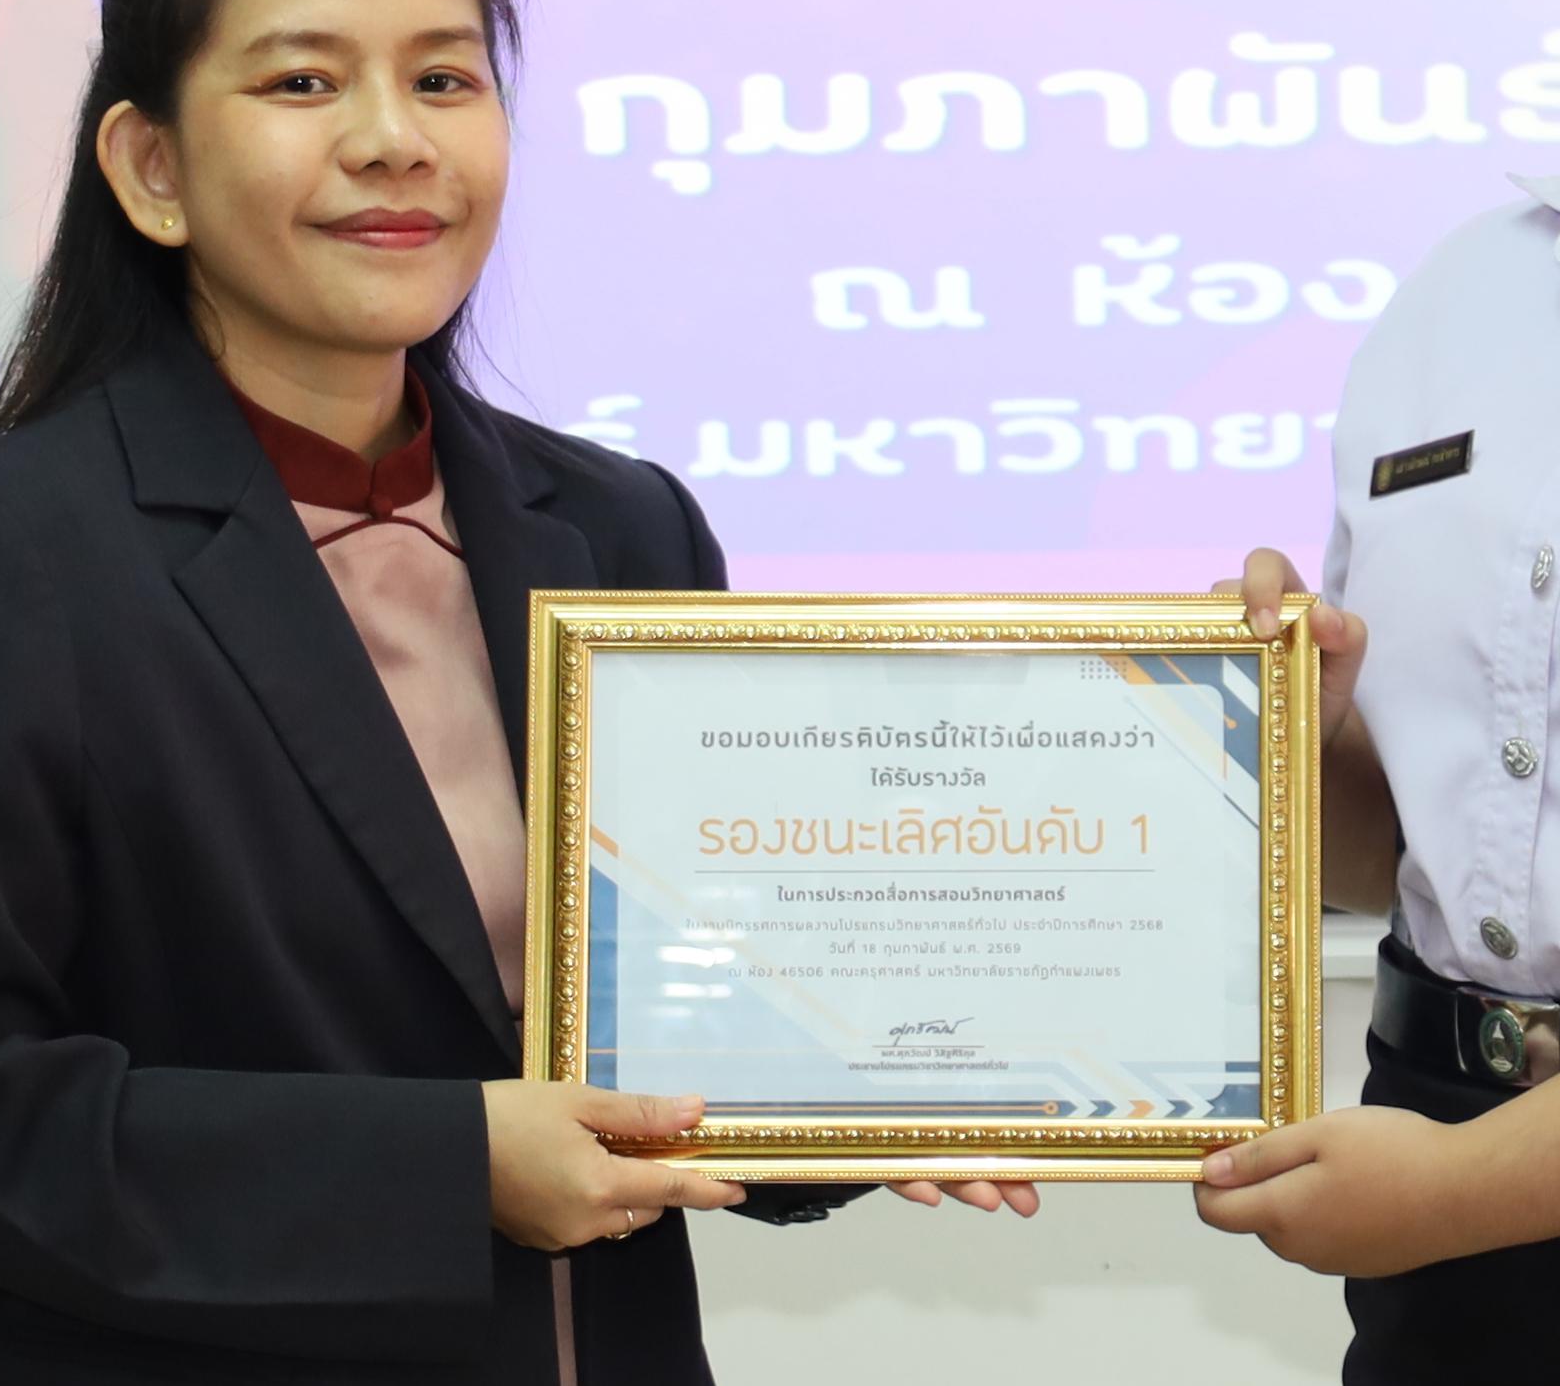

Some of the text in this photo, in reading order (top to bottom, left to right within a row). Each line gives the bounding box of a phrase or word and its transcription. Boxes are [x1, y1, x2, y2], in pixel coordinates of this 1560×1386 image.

[811, 233, 1397, 329] ณ ห้อง
[688, 399, 1337, 479] มหาวิทย
[870, 766, 987, 788] ได้รับรางวัล
[698, 805, 1151, 856] รองชนะเลิศอันดับ 1
[776, 881, 1067, 903] ในการประกวดสื่อการสอนวิทยาศาสตร์
[1129, 919, 1164, 931] 2568
[986, 942, 1022, 955] 2569
